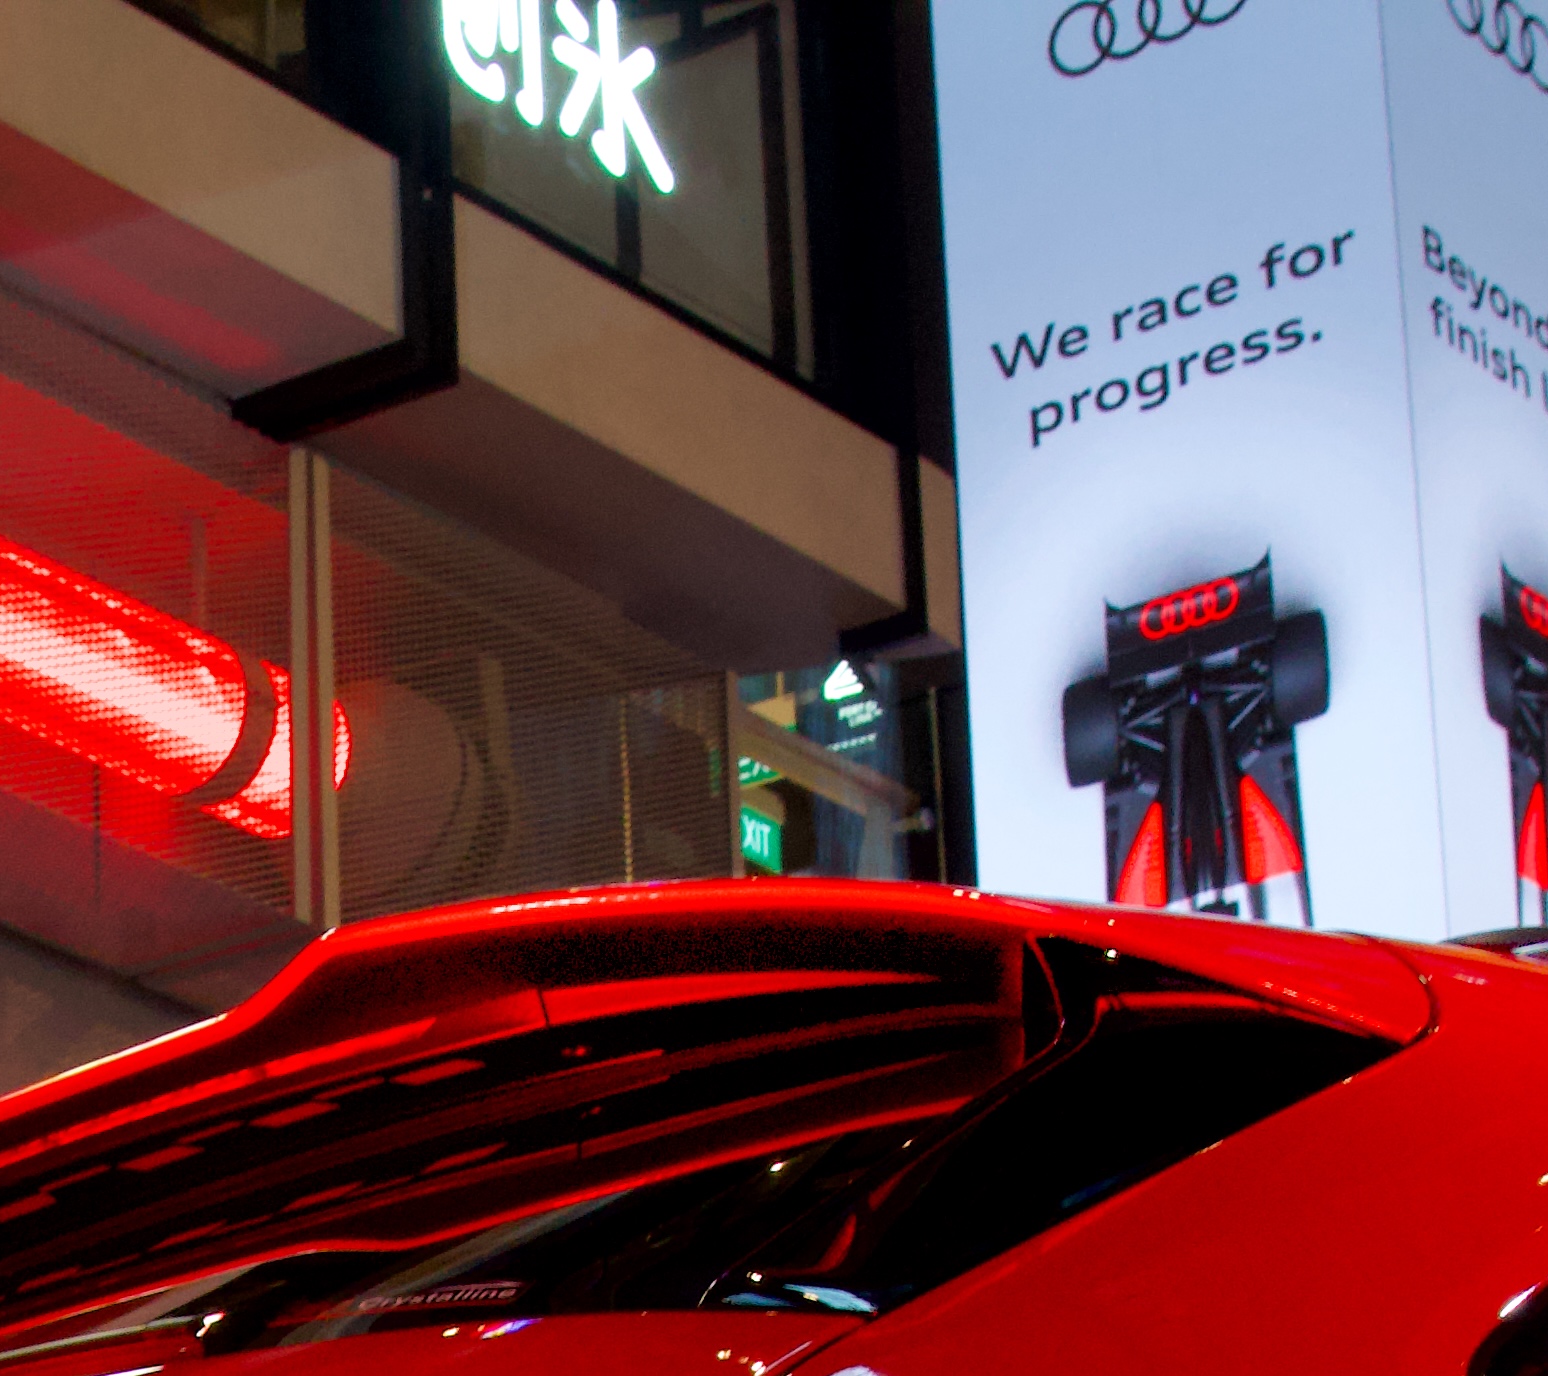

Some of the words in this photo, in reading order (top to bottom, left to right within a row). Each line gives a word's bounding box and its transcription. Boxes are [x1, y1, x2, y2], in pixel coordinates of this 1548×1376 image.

[990, 321, 1091, 380] We
[1111, 270, 1240, 342] race
[1258, 229, 1355, 290] for
[1429, 295, 1532, 400] finish
[1029, 316, 1324, 448] progress.
[741, 814, 772, 858] XIT
